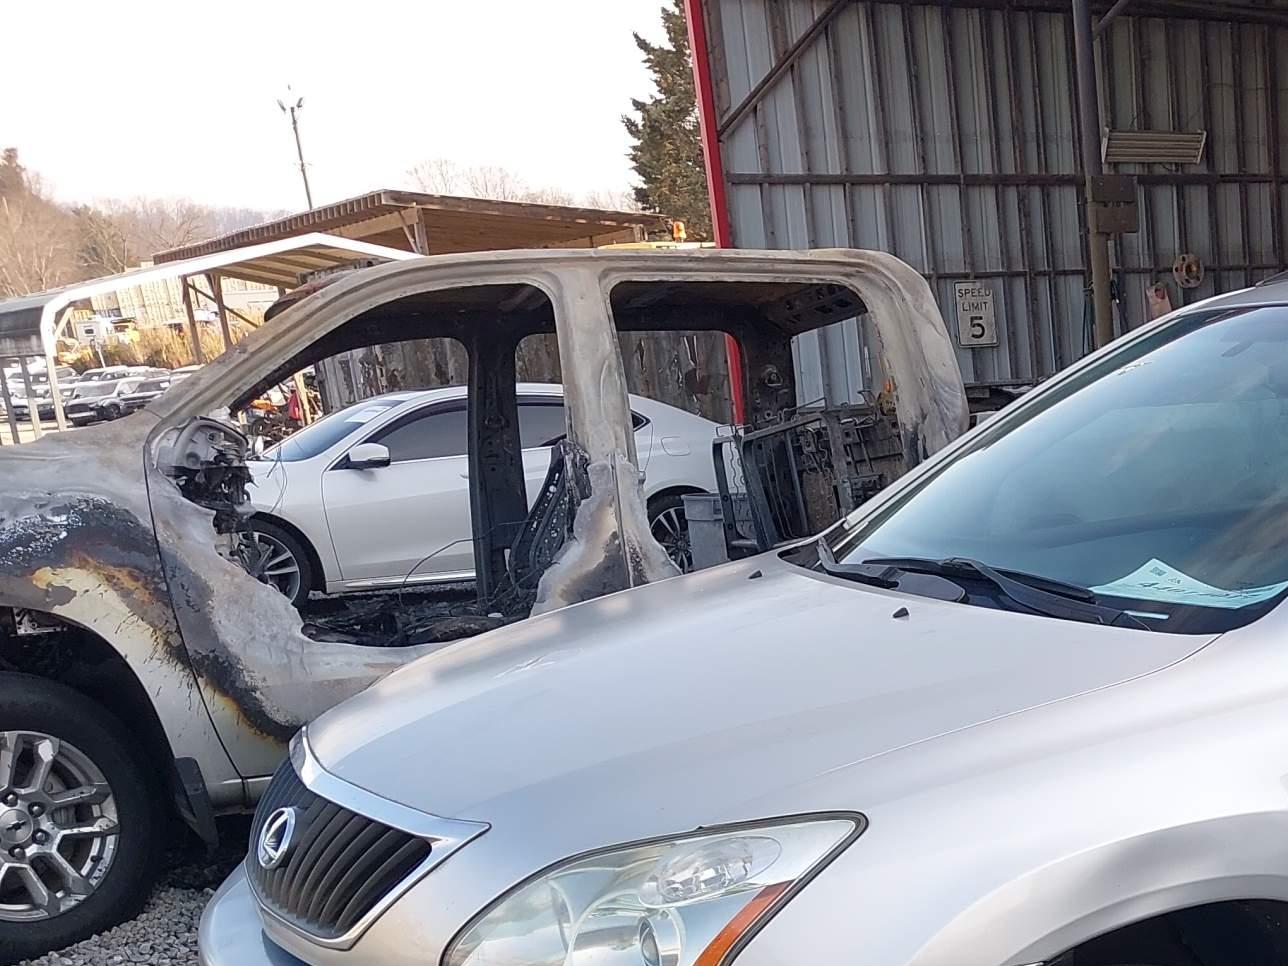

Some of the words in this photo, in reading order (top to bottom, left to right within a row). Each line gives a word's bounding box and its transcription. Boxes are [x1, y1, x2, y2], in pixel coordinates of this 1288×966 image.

[957, 288, 991, 298] SPEED
[962, 301, 988, 312] LIMIT
[969, 315, 986, 339] 5
